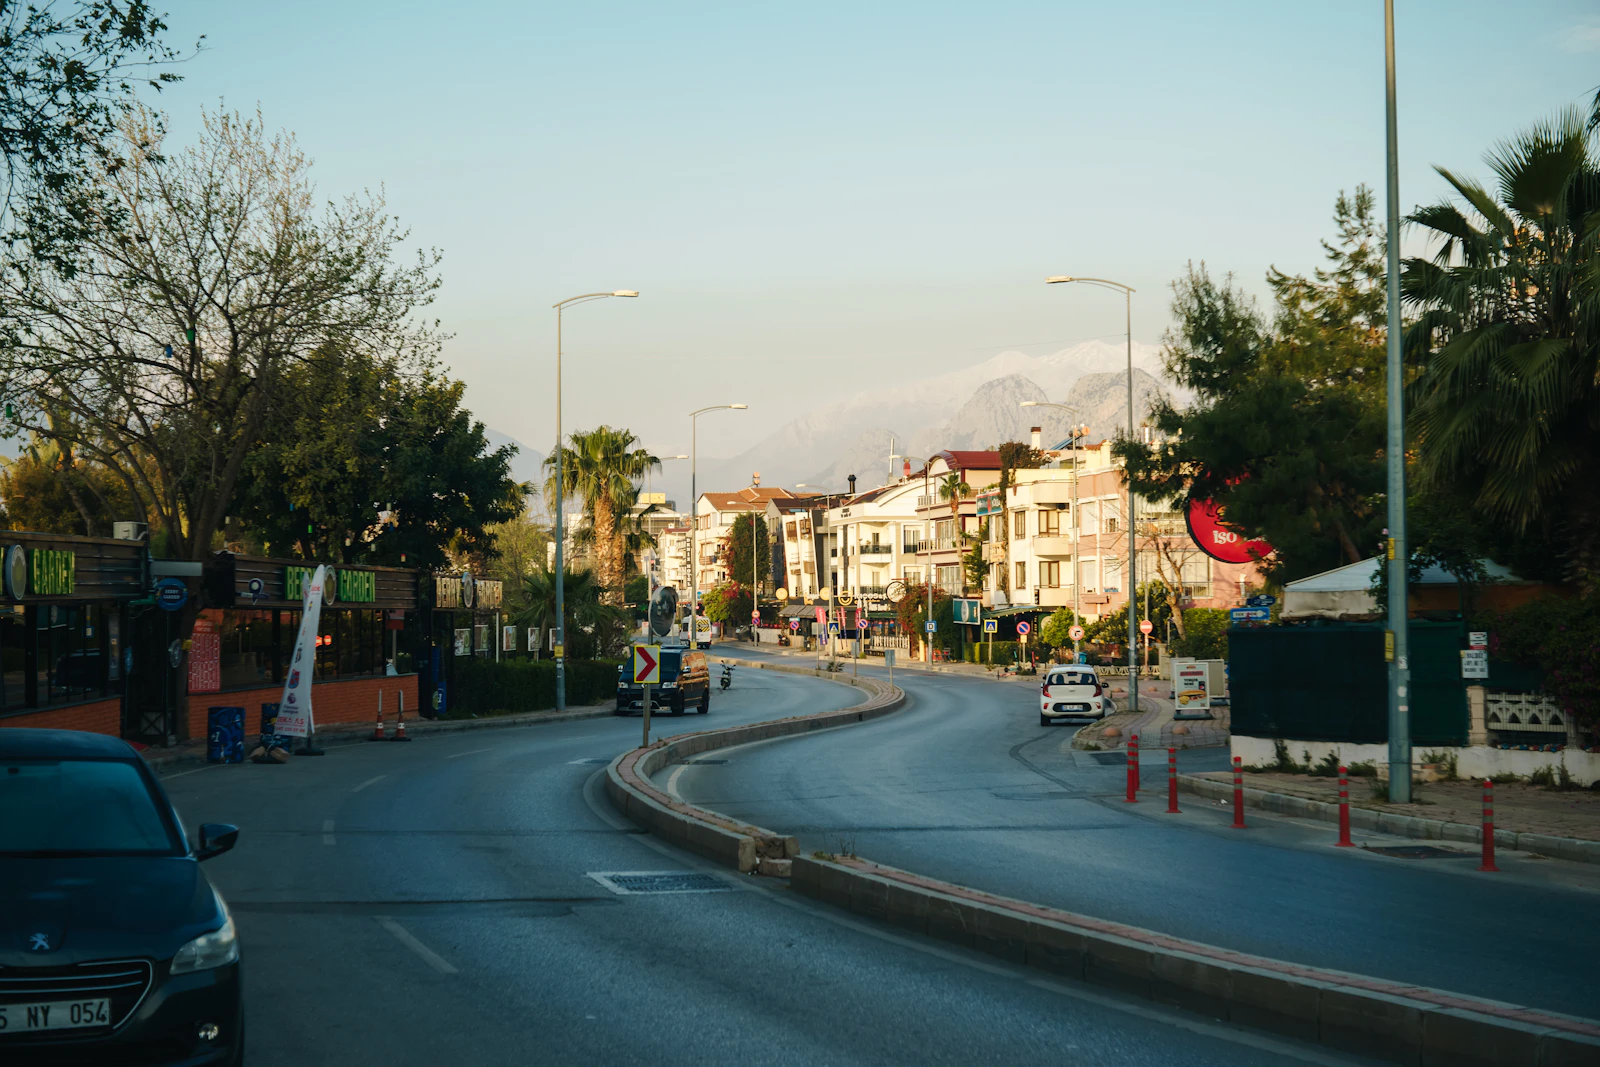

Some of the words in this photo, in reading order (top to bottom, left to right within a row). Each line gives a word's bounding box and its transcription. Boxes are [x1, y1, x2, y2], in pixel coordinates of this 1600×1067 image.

[32, 548, 75, 595] GARDEN
[339, 569, 376, 602] GARDEN
[27, 1005, 50, 1028] NY
[70, 1001, 107, 1024] 054
